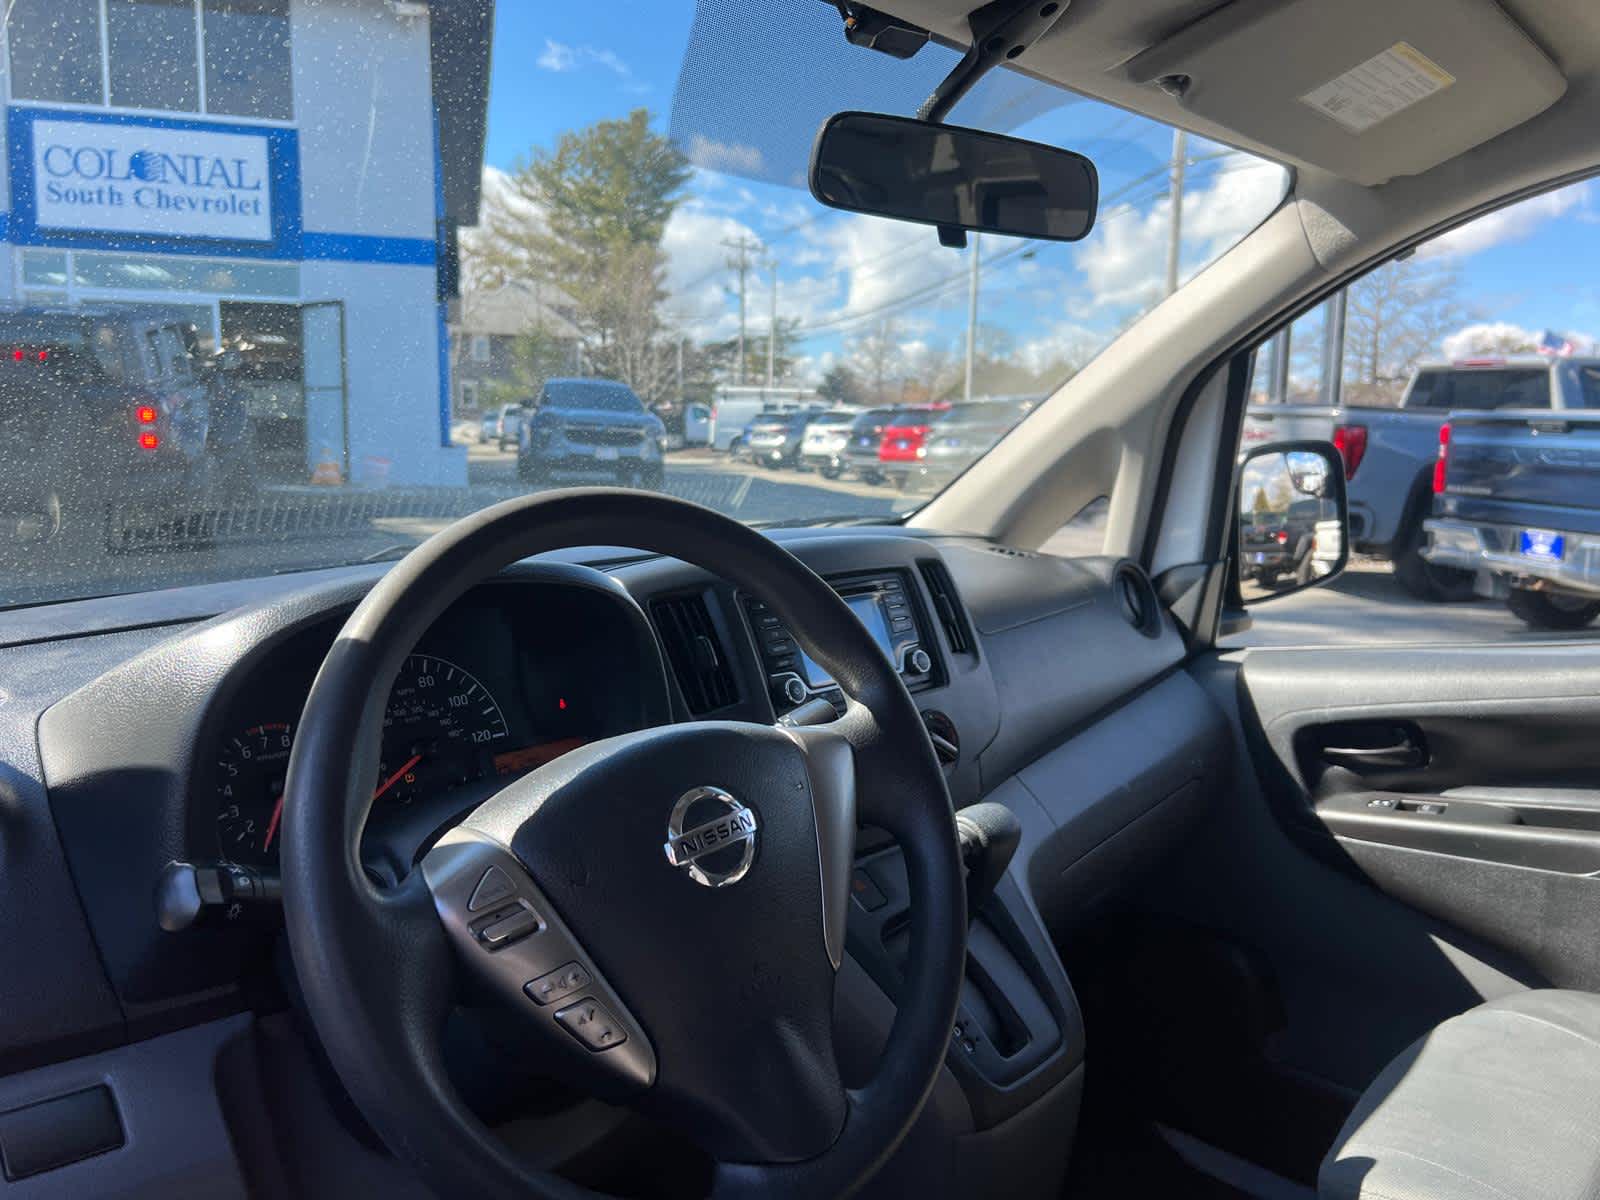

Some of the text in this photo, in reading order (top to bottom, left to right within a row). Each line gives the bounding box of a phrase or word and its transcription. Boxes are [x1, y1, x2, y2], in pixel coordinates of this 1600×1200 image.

[43, 144, 262, 191] COLONIAL
[46, 181, 262, 216] South Chevrolet
[418, 674, 435, 688] 80
[448, 693, 469, 707] 100
[259, 735, 269, 749] 7
[471, 730, 492, 744] 120
[241, 746, 252, 760] 6
[228, 763, 239, 777] 5
[223, 784, 233, 797] 4
[229, 804, 240, 818] 3
[245, 818, 256, 833] 2
[680, 813, 753, 856] NISSAN
